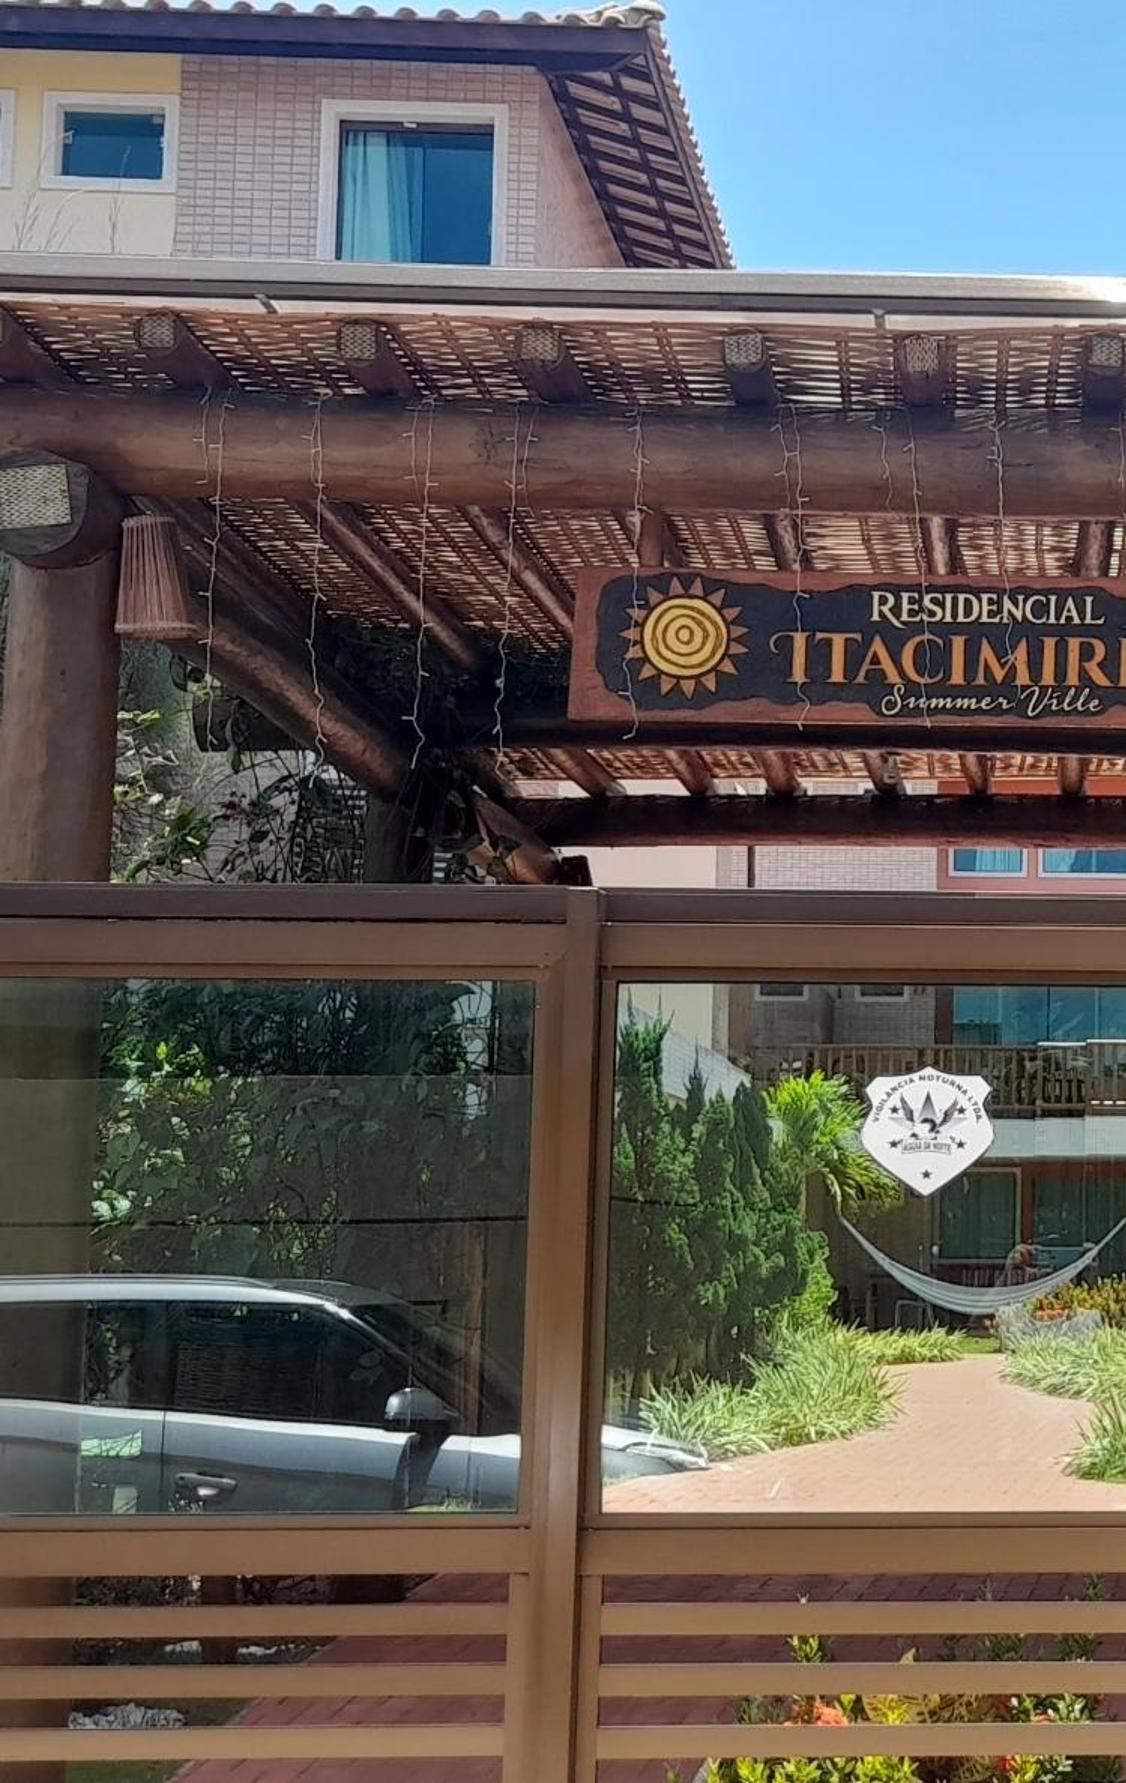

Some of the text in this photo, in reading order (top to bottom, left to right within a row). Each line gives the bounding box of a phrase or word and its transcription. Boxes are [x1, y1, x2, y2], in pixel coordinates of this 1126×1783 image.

[871, 591, 1105, 628] RESIDENCIAL
[881, 685, 1102, 716] Summer Ville
[918, 1074, 969, 1097] NOTURNA
